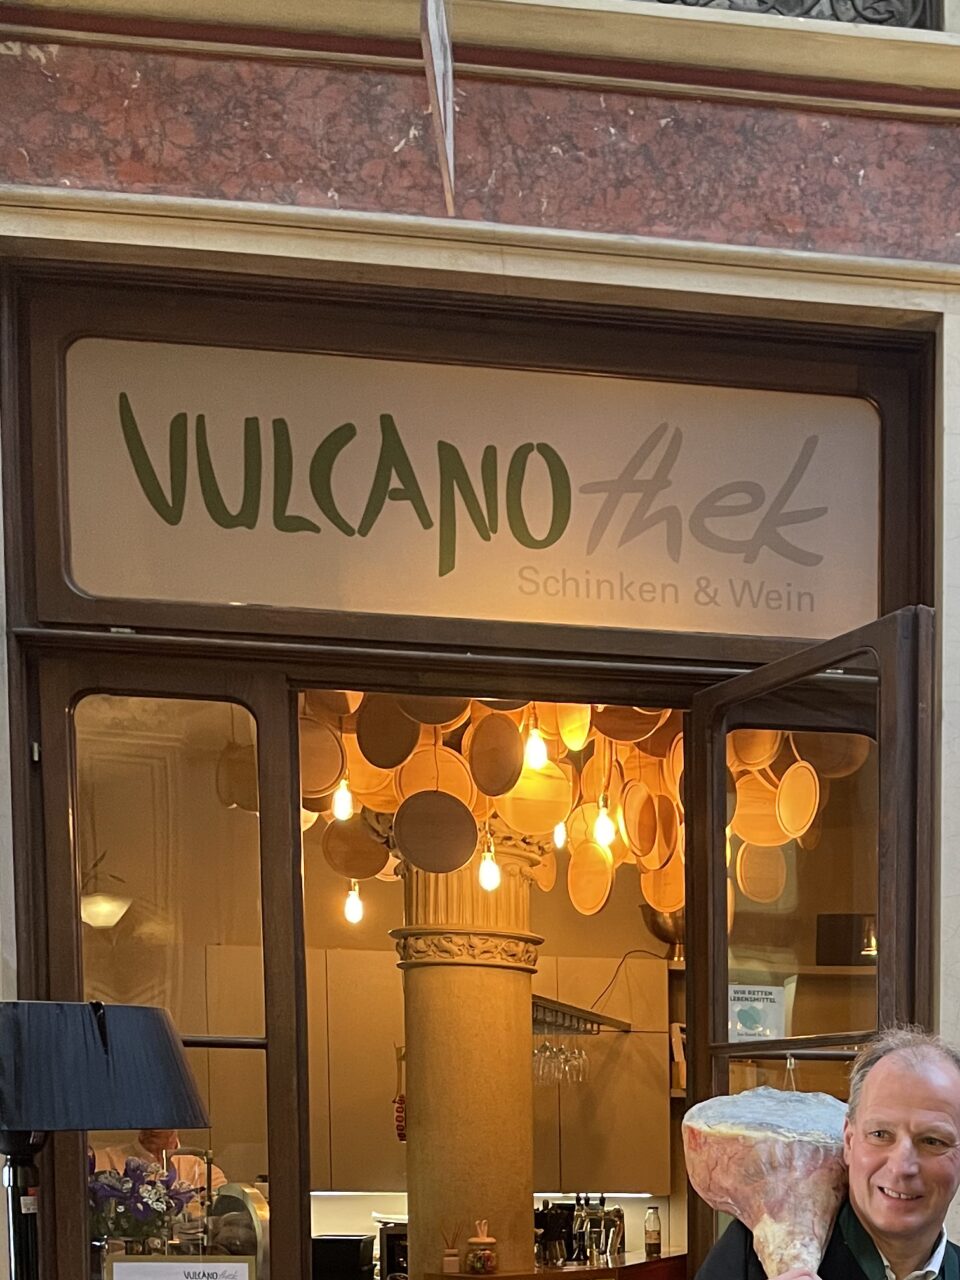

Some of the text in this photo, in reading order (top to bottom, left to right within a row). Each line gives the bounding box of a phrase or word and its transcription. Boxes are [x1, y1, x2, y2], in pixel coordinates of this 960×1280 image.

[517, 565, 815, 612] Schinken & Wein
